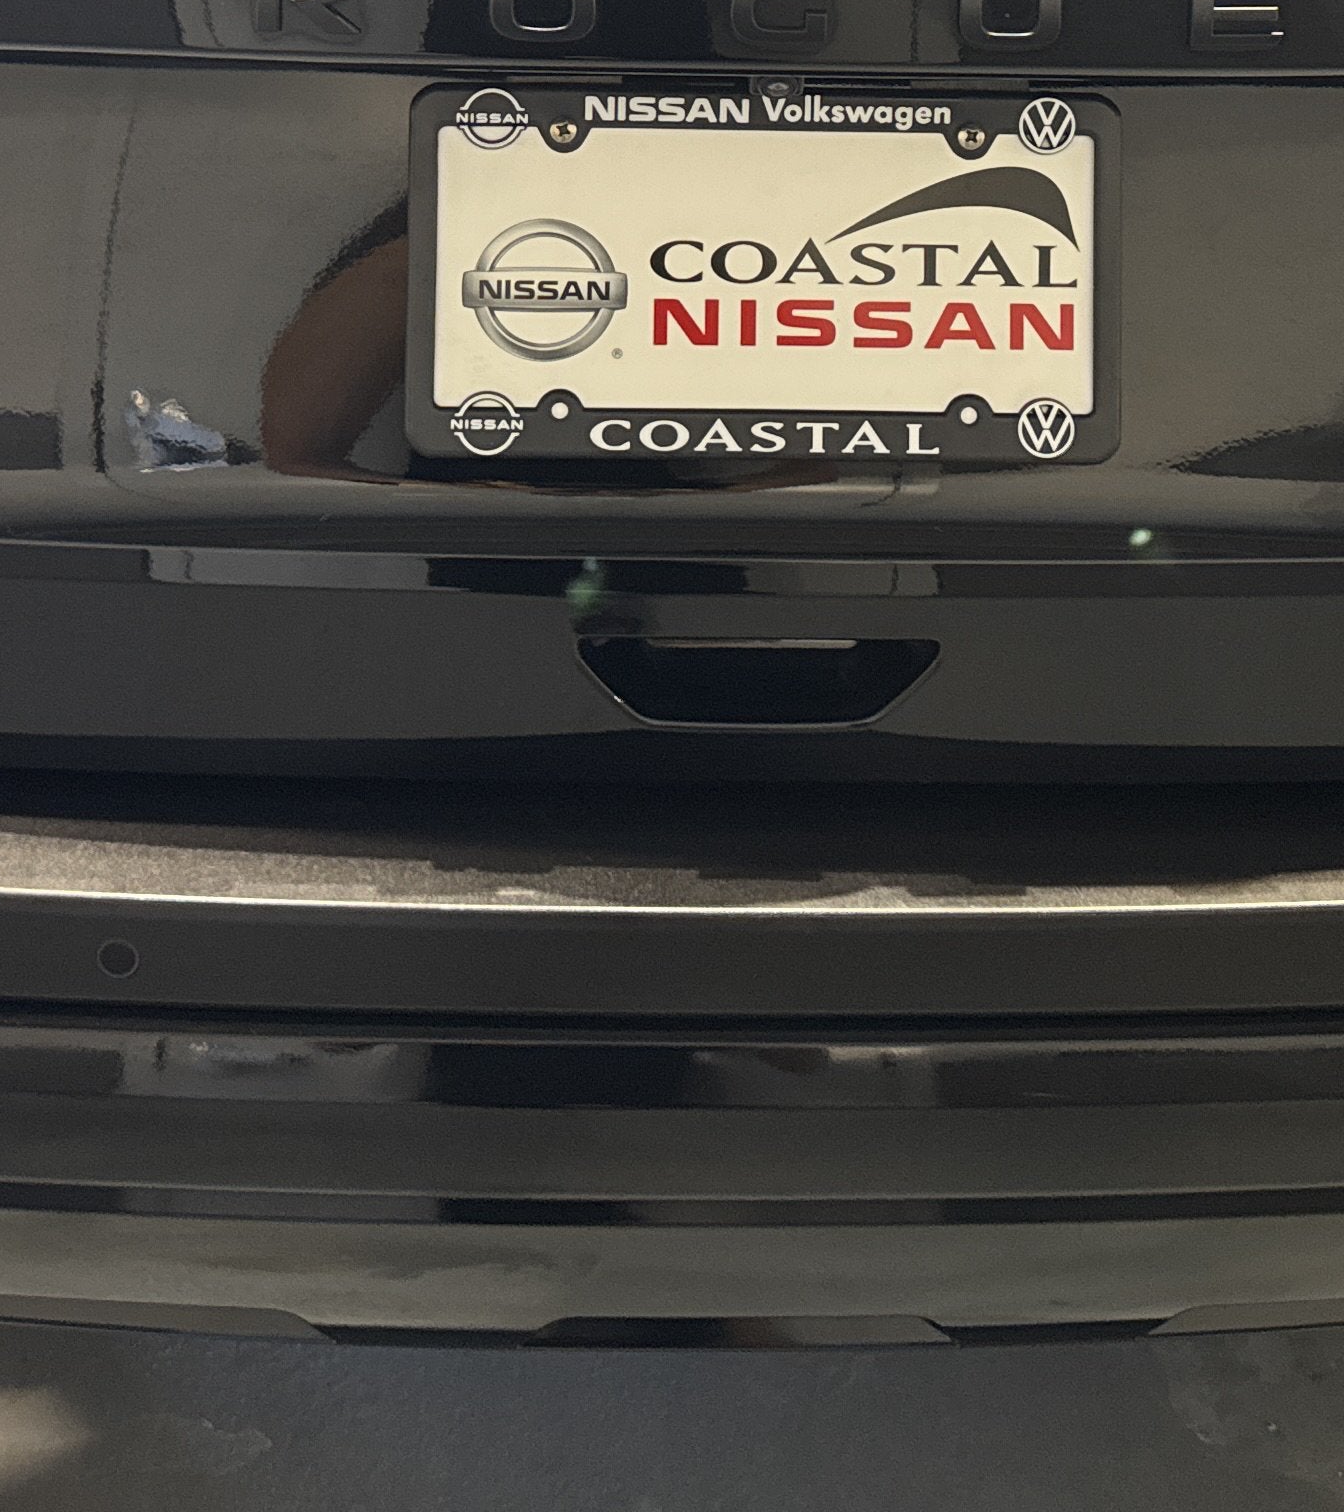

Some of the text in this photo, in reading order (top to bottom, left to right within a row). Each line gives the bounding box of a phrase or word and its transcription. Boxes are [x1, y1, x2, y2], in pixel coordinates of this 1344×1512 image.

[456, 111, 529, 125] NISSAN
[584, 94, 952, 131] NISSAN Volkswagen
[649, 237, 1078, 288] COASTAL
[478, 279, 611, 301] NISSAN
[652, 298, 1075, 351] NISSAN
[450, 418, 524, 431] NISSAN
[589, 417, 940, 455] COASTAL
